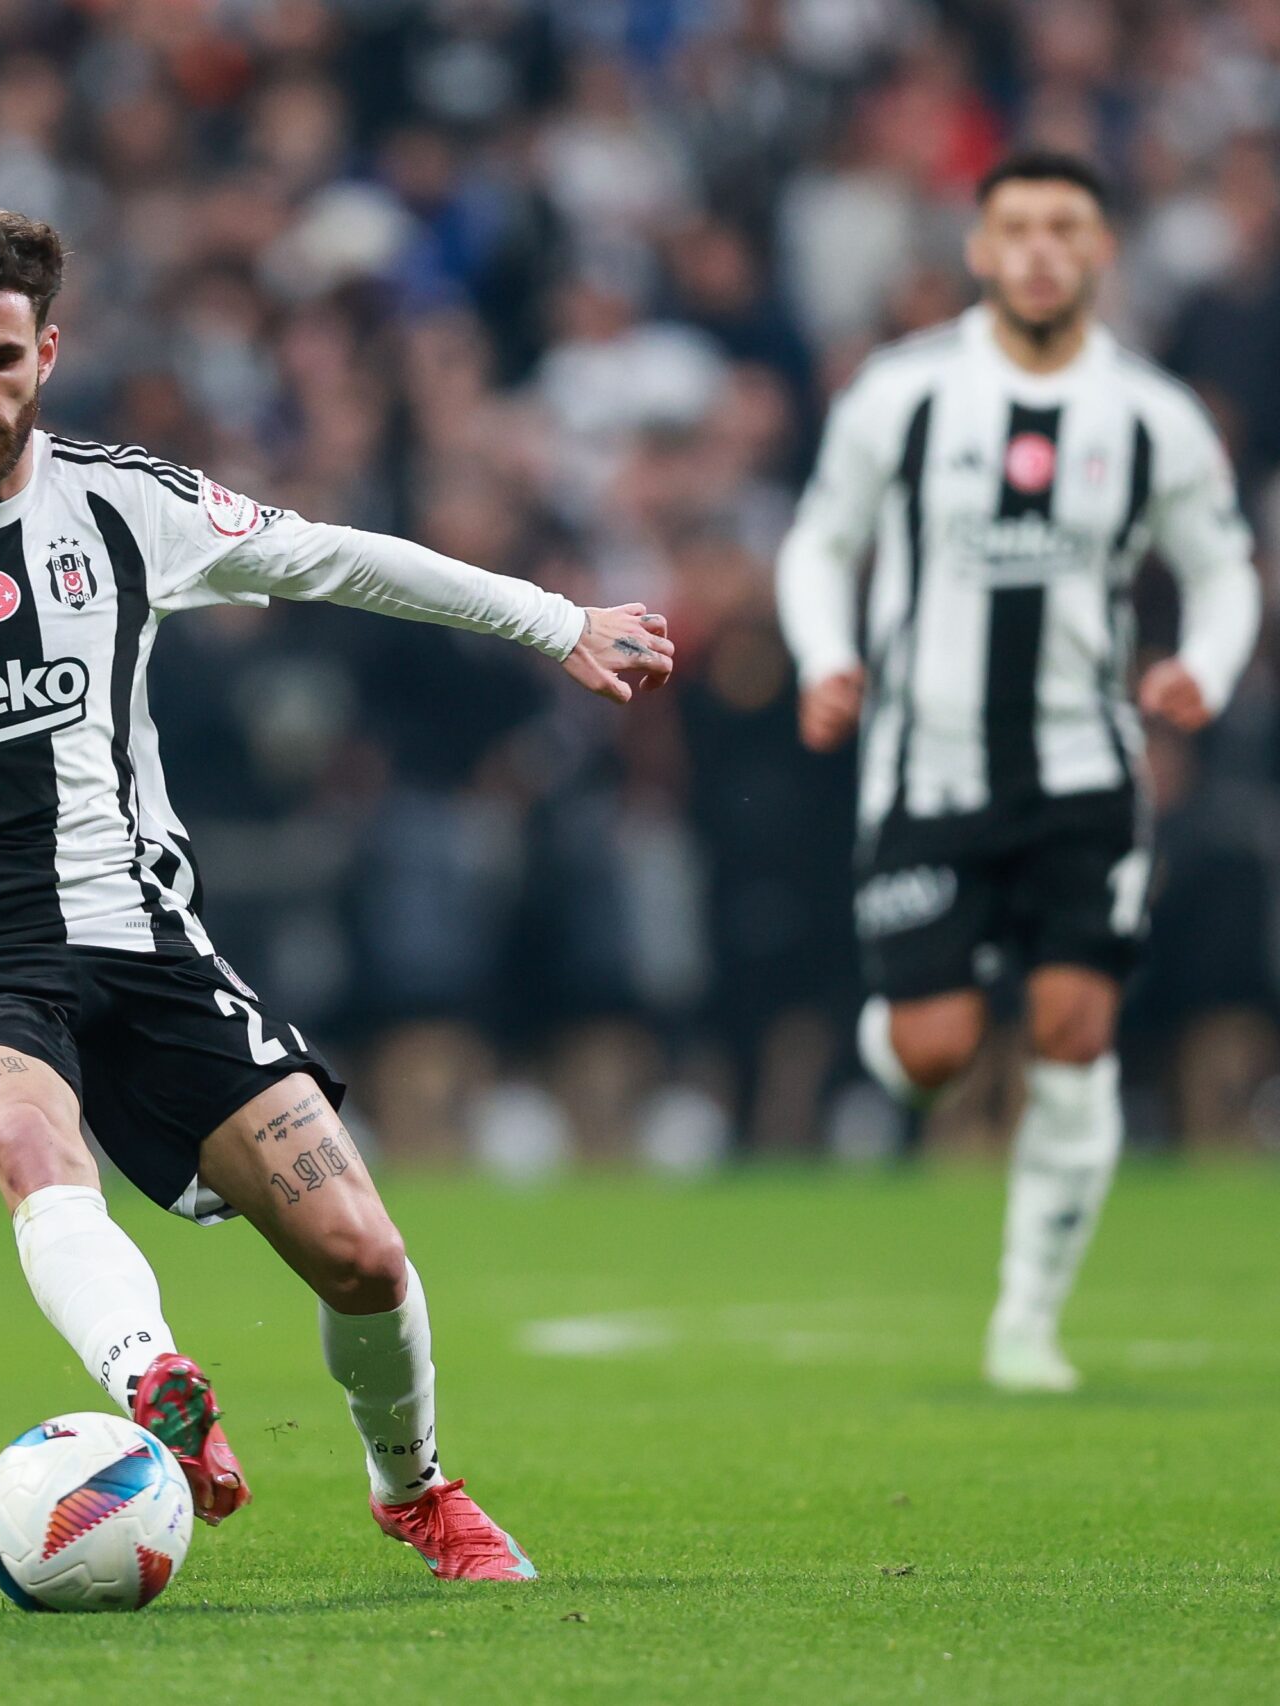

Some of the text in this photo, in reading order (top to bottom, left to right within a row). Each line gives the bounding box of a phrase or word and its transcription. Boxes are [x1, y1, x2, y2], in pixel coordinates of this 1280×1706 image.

[53, 555, 84, 571] BJK
[64, 593, 91, 604] 1903
[213, 988, 309, 1066] 2
[255, 1128, 267, 1142] MY
[267, 1111, 291, 1132] MOM
[273, 1126, 288, 1142] MY
